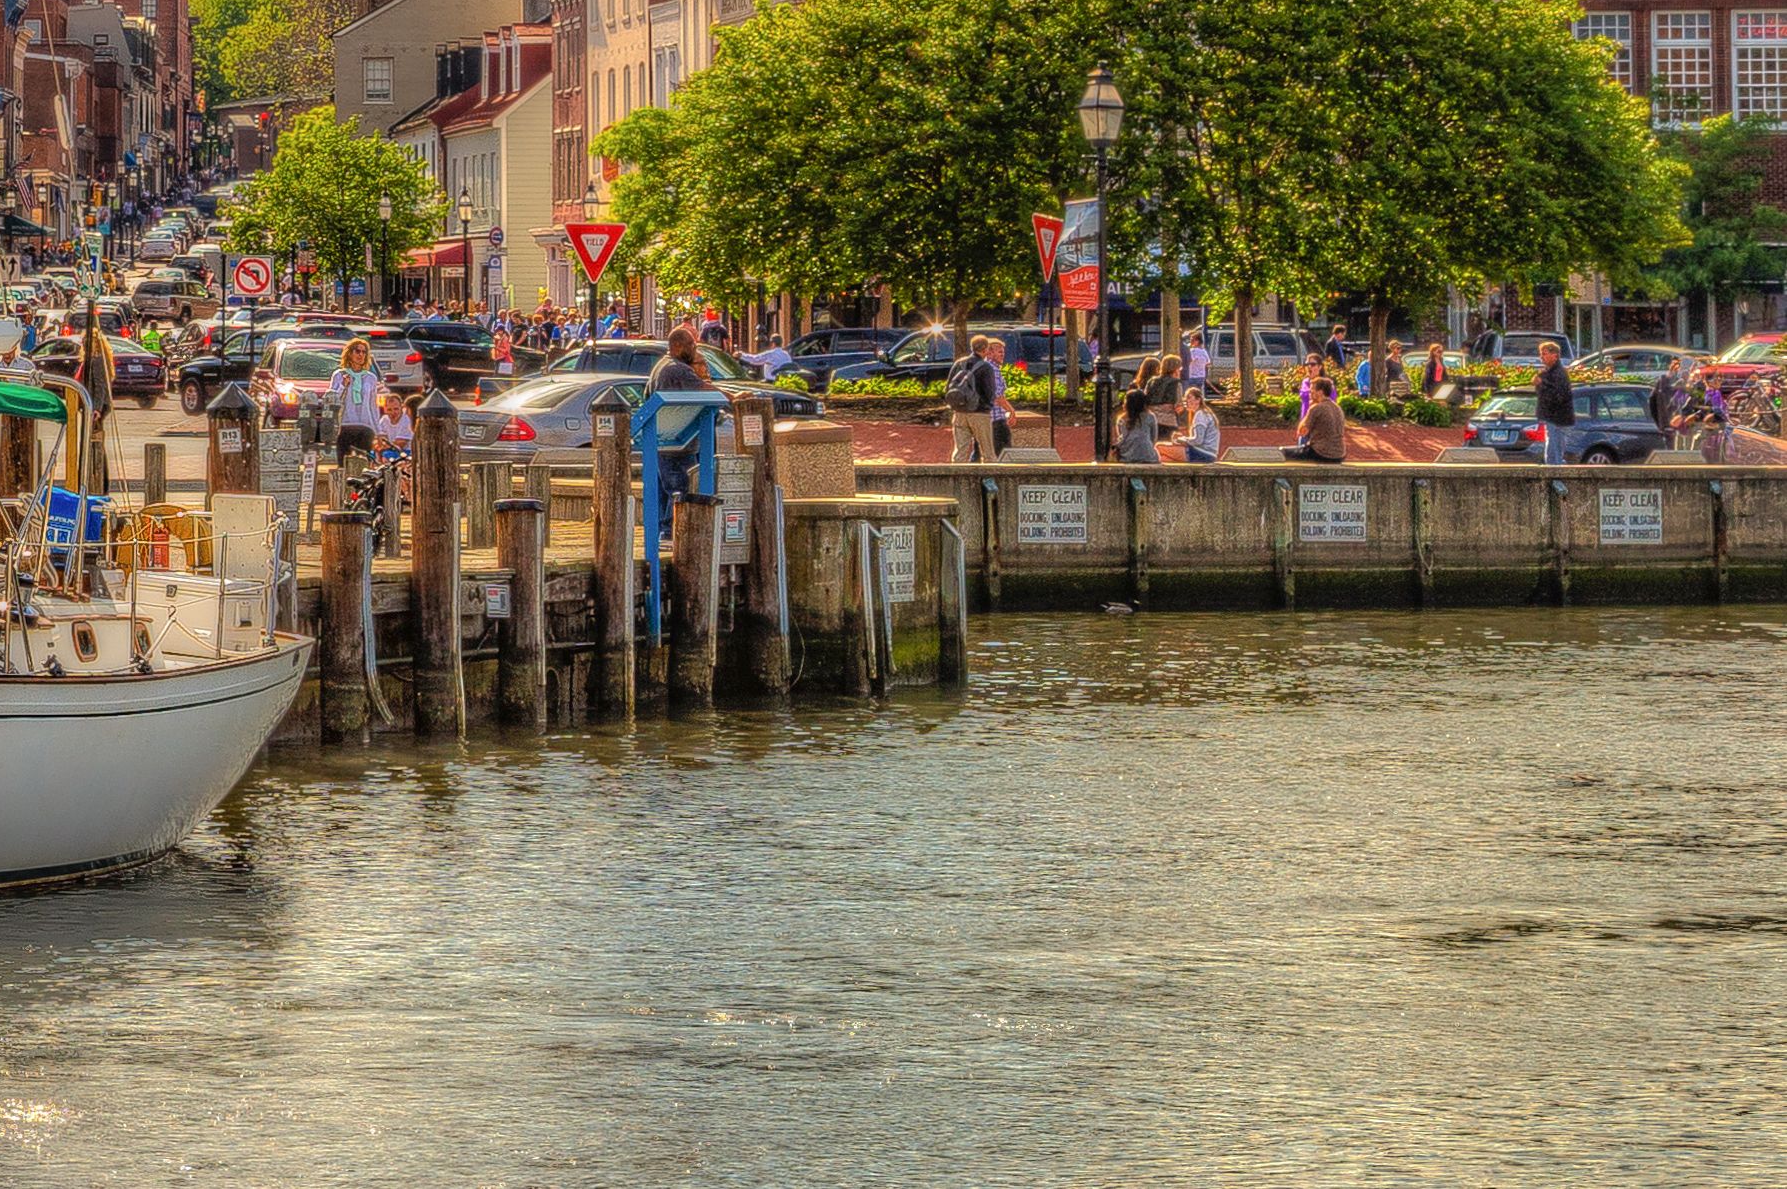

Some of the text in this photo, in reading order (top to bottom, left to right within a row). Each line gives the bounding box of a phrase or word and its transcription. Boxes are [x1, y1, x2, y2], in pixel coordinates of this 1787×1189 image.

[586, 238, 604, 247] YIELD
[222, 431, 238, 439] R13
[1022, 491, 1083, 504] KEEP CLEAR
[1303, 490, 1363, 504] KEEP CLEAR
[1603, 494, 1658, 507] KEEP CLEAR
